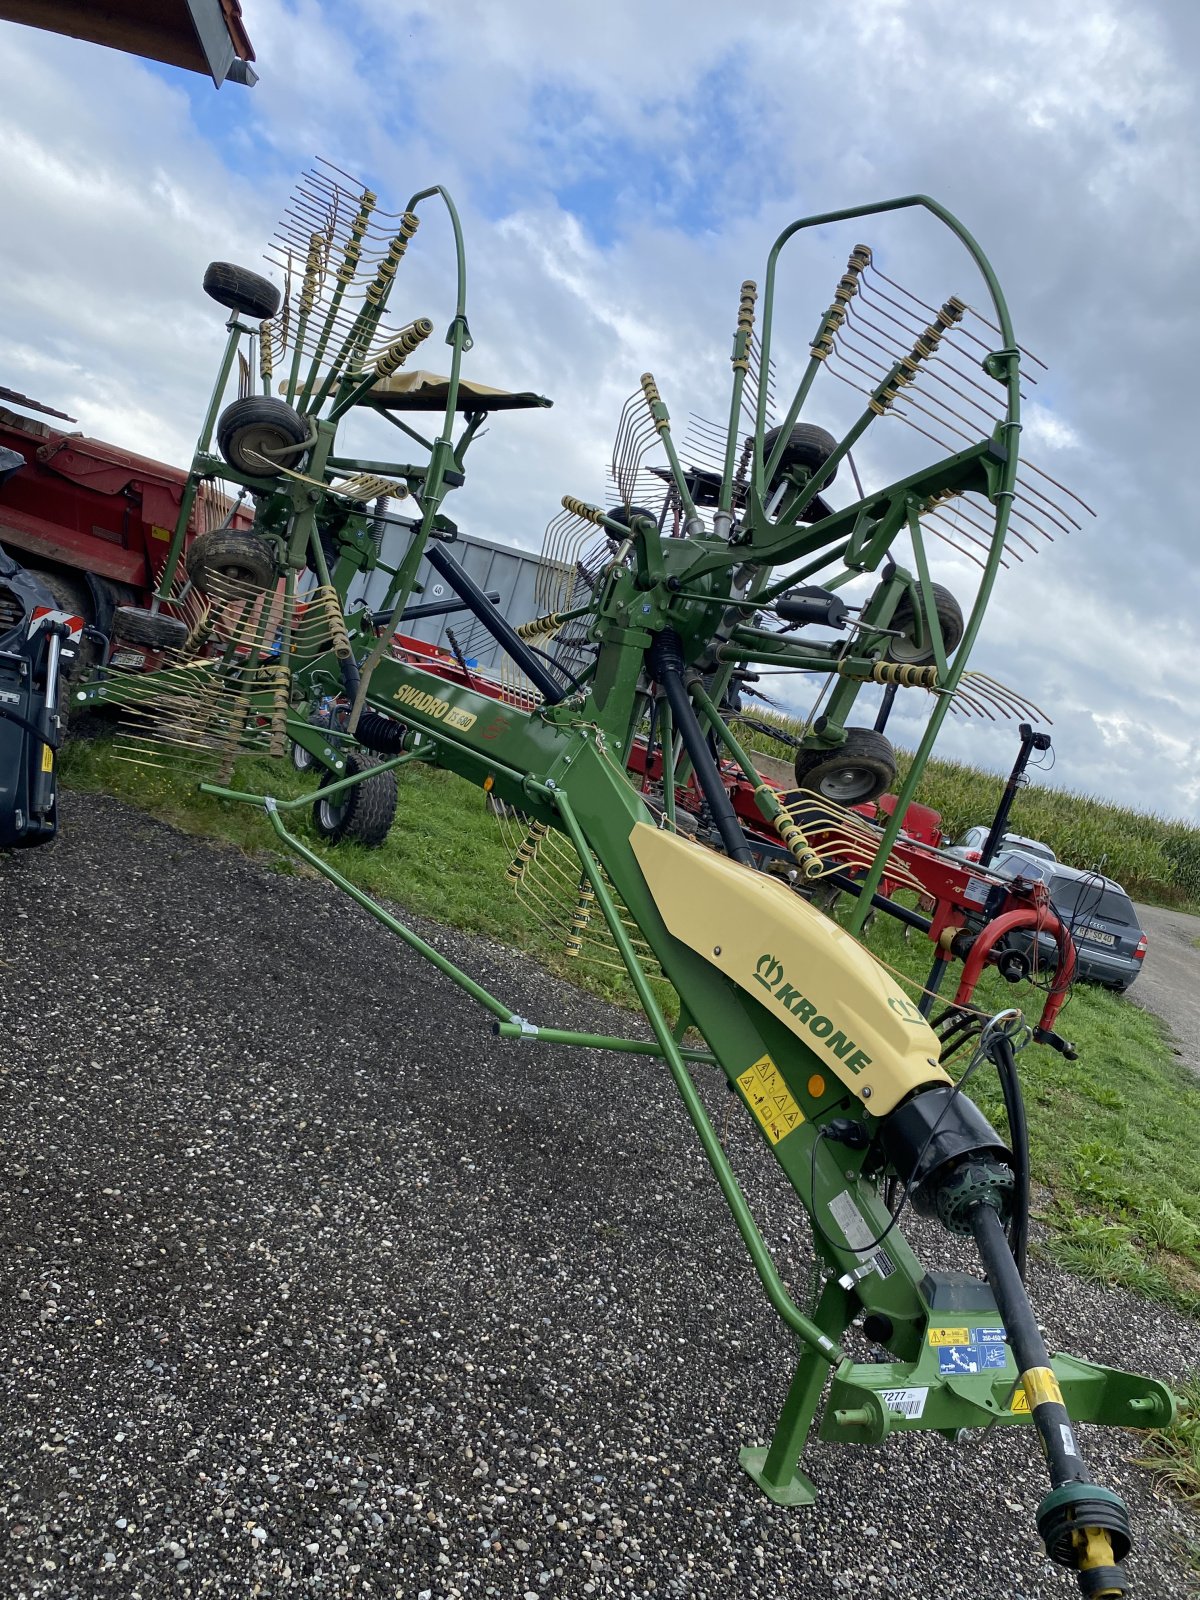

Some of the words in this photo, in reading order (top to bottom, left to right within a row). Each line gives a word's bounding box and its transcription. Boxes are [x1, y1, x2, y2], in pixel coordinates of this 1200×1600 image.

[393, 684, 449, 718] SWADRO
[448, 711, 459, 721] TS
[457, 715, 472, 727] 680
[774, 982, 873, 1075] KRONE
